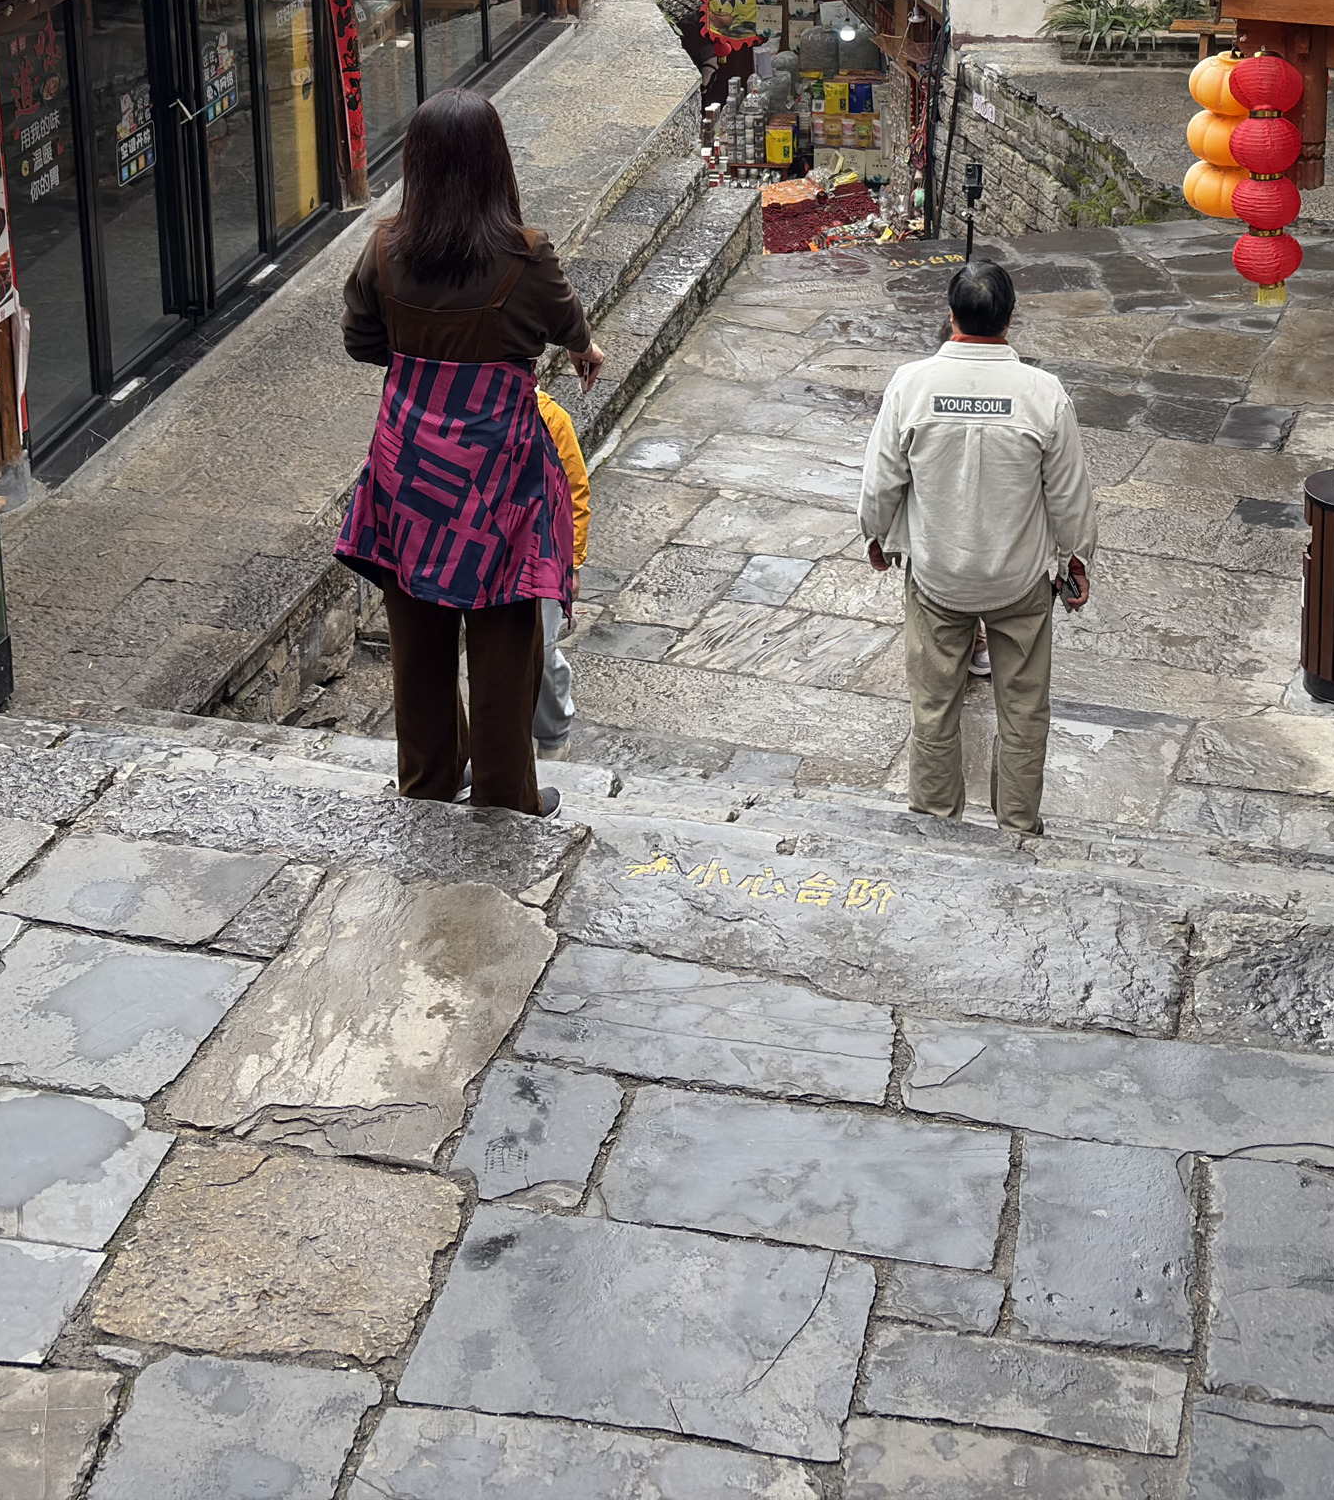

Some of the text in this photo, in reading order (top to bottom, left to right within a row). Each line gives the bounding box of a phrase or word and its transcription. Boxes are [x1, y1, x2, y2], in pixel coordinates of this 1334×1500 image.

[21, 109, 61, 152] 用我的味
[120, 128, 151, 161] 空调开放
[33, 141, 53, 173] 温暖
[30, 165, 60, 204] 你的胃
[940, 398, 1006, 413] YOUR SOUL
[685, 857, 895, 914] 小心台阶
